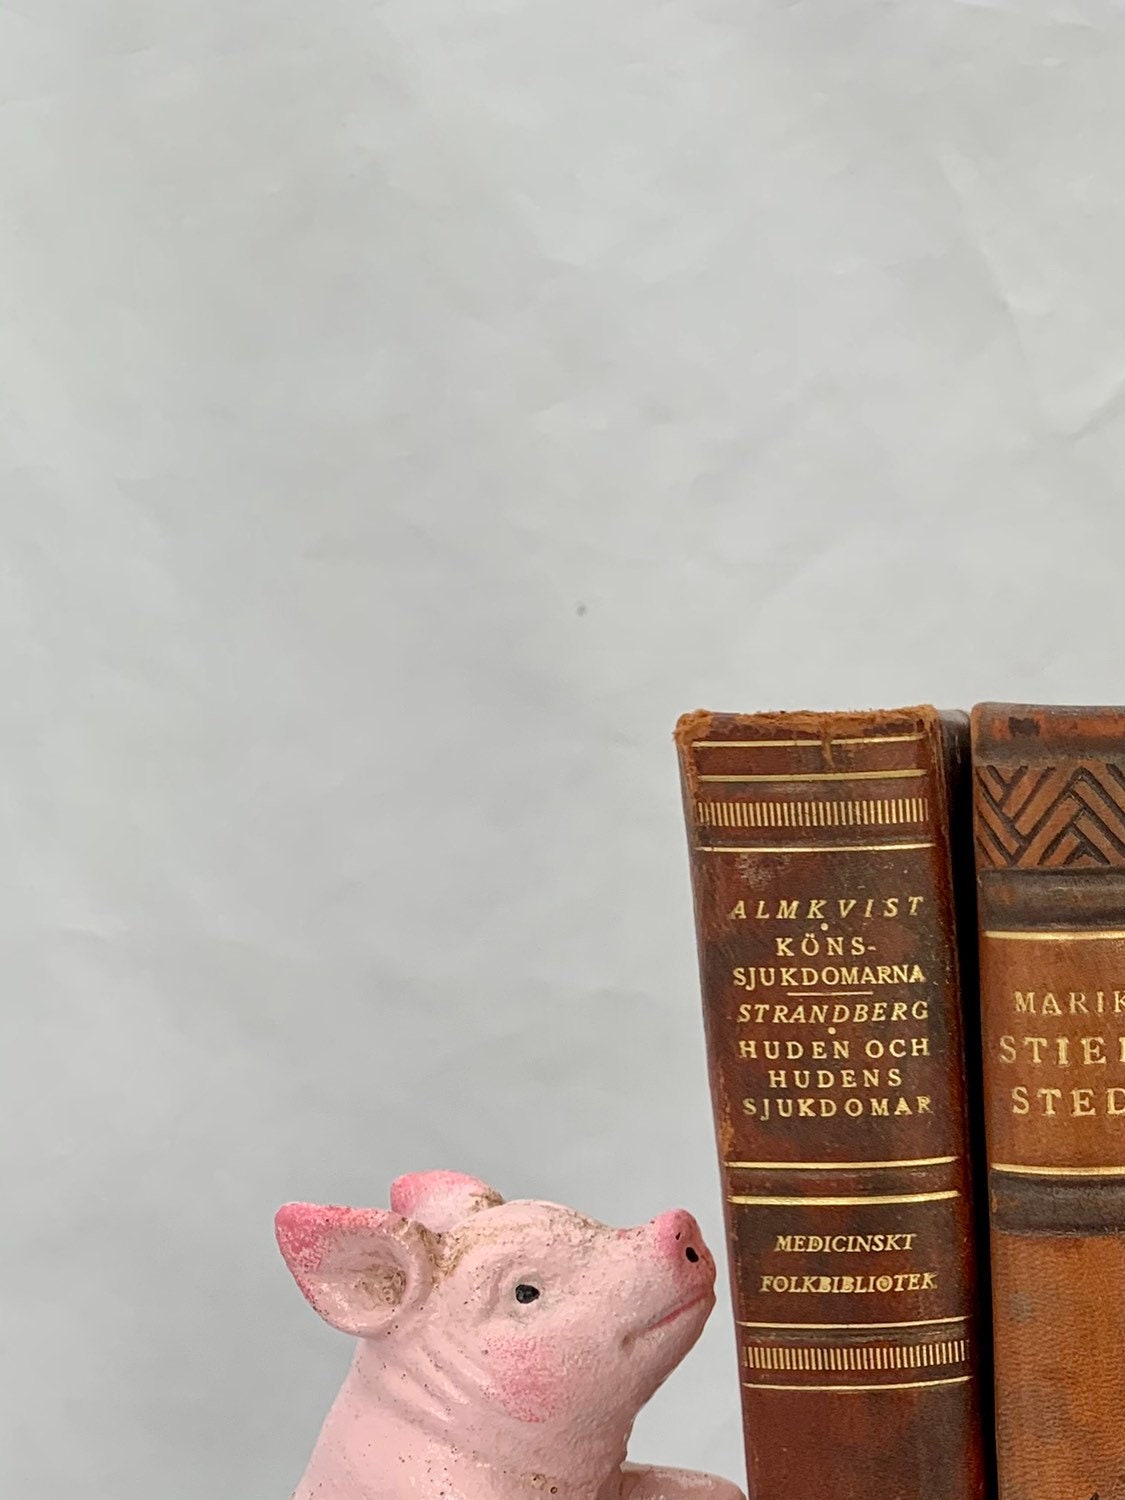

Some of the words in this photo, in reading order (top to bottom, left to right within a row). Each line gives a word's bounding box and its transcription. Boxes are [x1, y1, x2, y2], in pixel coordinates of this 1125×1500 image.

[729, 896, 923, 919] ALMKVIST
[776, 933, 876, 956] KÖNS-
[733, 965, 925, 990] SJUKDOMARNA
[737, 1001, 929, 1023] STRANDBERG
[738, 1040, 850, 1059] HUDEN
[865, 1038, 930, 1058] OCH
[768, 1069, 902, 1088] HUDENS
[743, 1096, 932, 1121] SJUKDOMAR
[774, 1233, 917, 1252] MEDICINSKT
[759, 1272, 938, 1293] FOLKBIBLIOTEK
